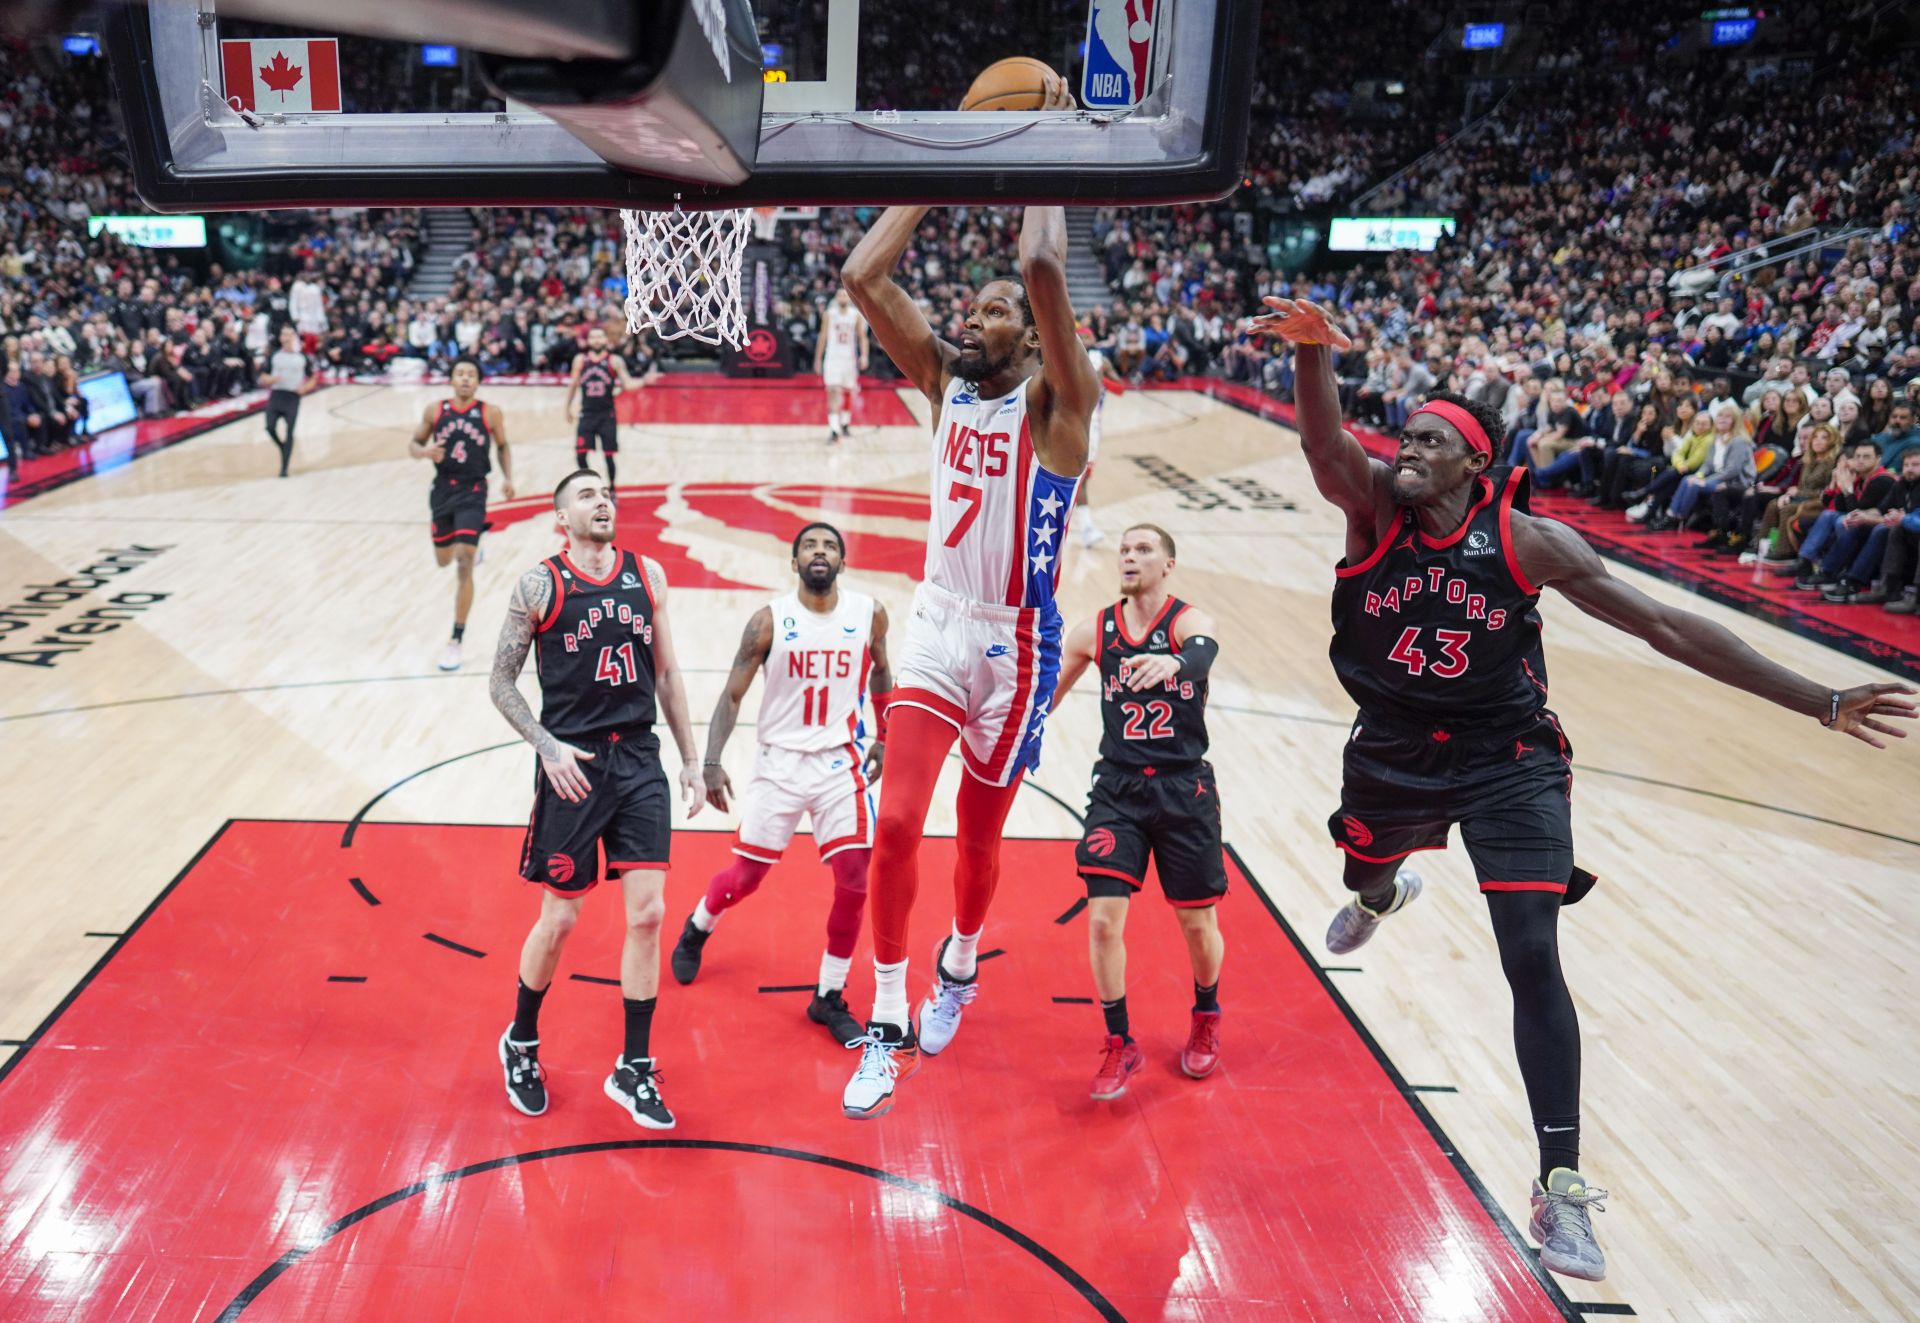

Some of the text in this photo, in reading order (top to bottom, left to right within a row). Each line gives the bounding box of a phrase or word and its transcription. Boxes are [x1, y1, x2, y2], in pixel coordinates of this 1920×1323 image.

[1091, 73, 1123, 98] NBA
[450, 440, 468, 464] 4
[943, 421, 1011, 479] NETS
[943, 480, 983, 549] 7
[1463, 546, 1497, 557] Sun Life
[1364, 566, 1507, 631] RAPTORS
[563, 598, 653, 652] RAPTORS
[595, 642, 637, 687] 41
[788, 650, 852, 679] NETS
[1387, 626, 1472, 679] 43
[1103, 661, 1194, 702] RAPRS
[802, 685, 829, 727] 11
[1120, 699, 1175, 740] 22
